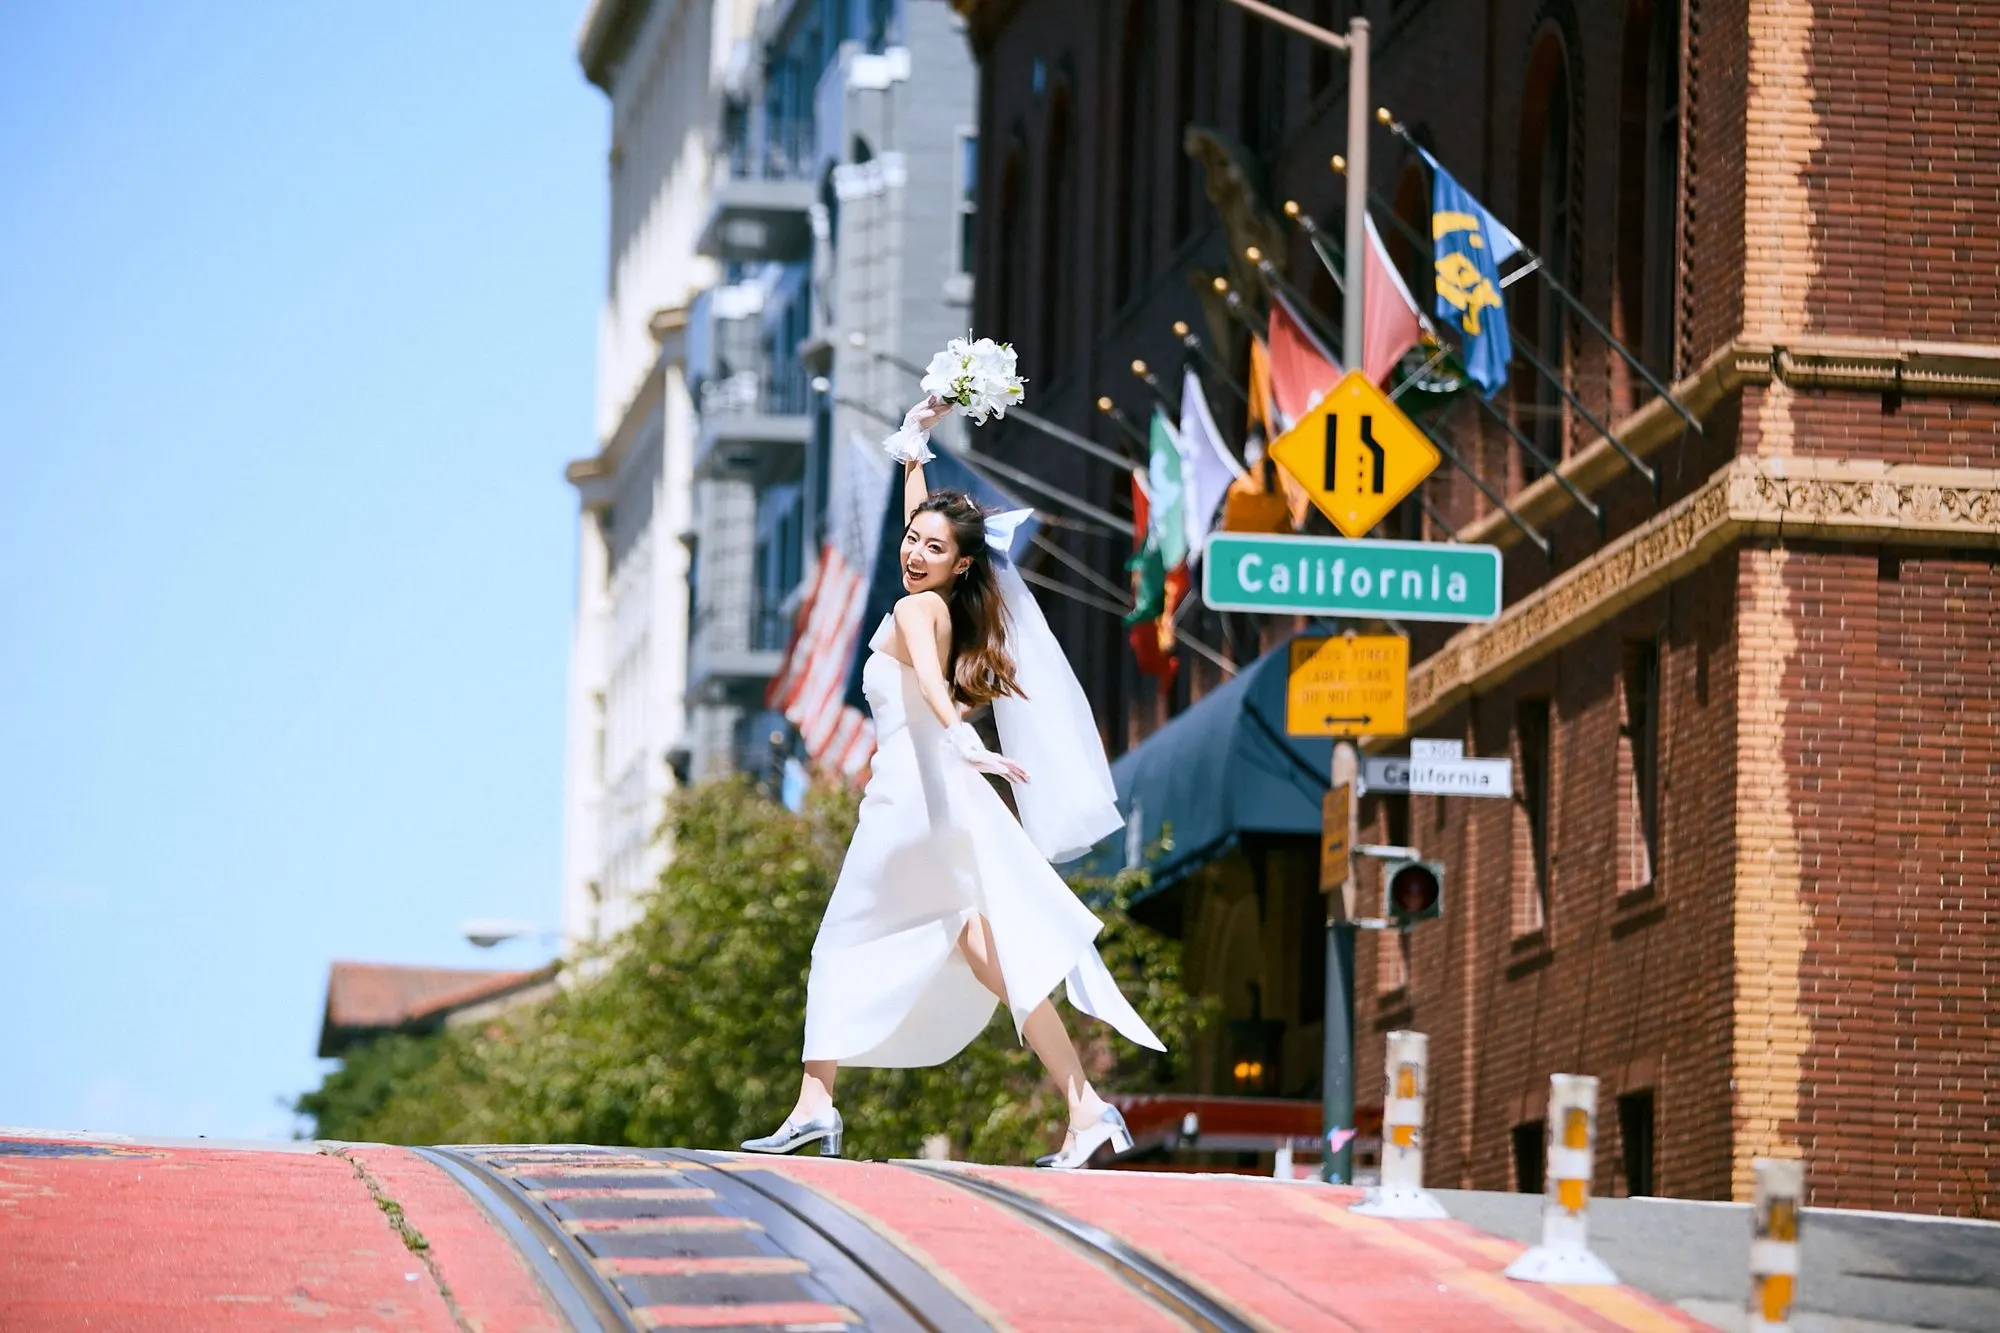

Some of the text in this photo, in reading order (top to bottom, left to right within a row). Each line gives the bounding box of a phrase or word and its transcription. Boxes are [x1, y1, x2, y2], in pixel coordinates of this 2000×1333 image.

[1237, 553, 1468, 602] California
[1356, 668, 1391, 682] CARS
[1326, 690, 1354, 704] NOT
[1360, 690, 1394, 704] STOP
[1383, 763, 1490, 785] California
